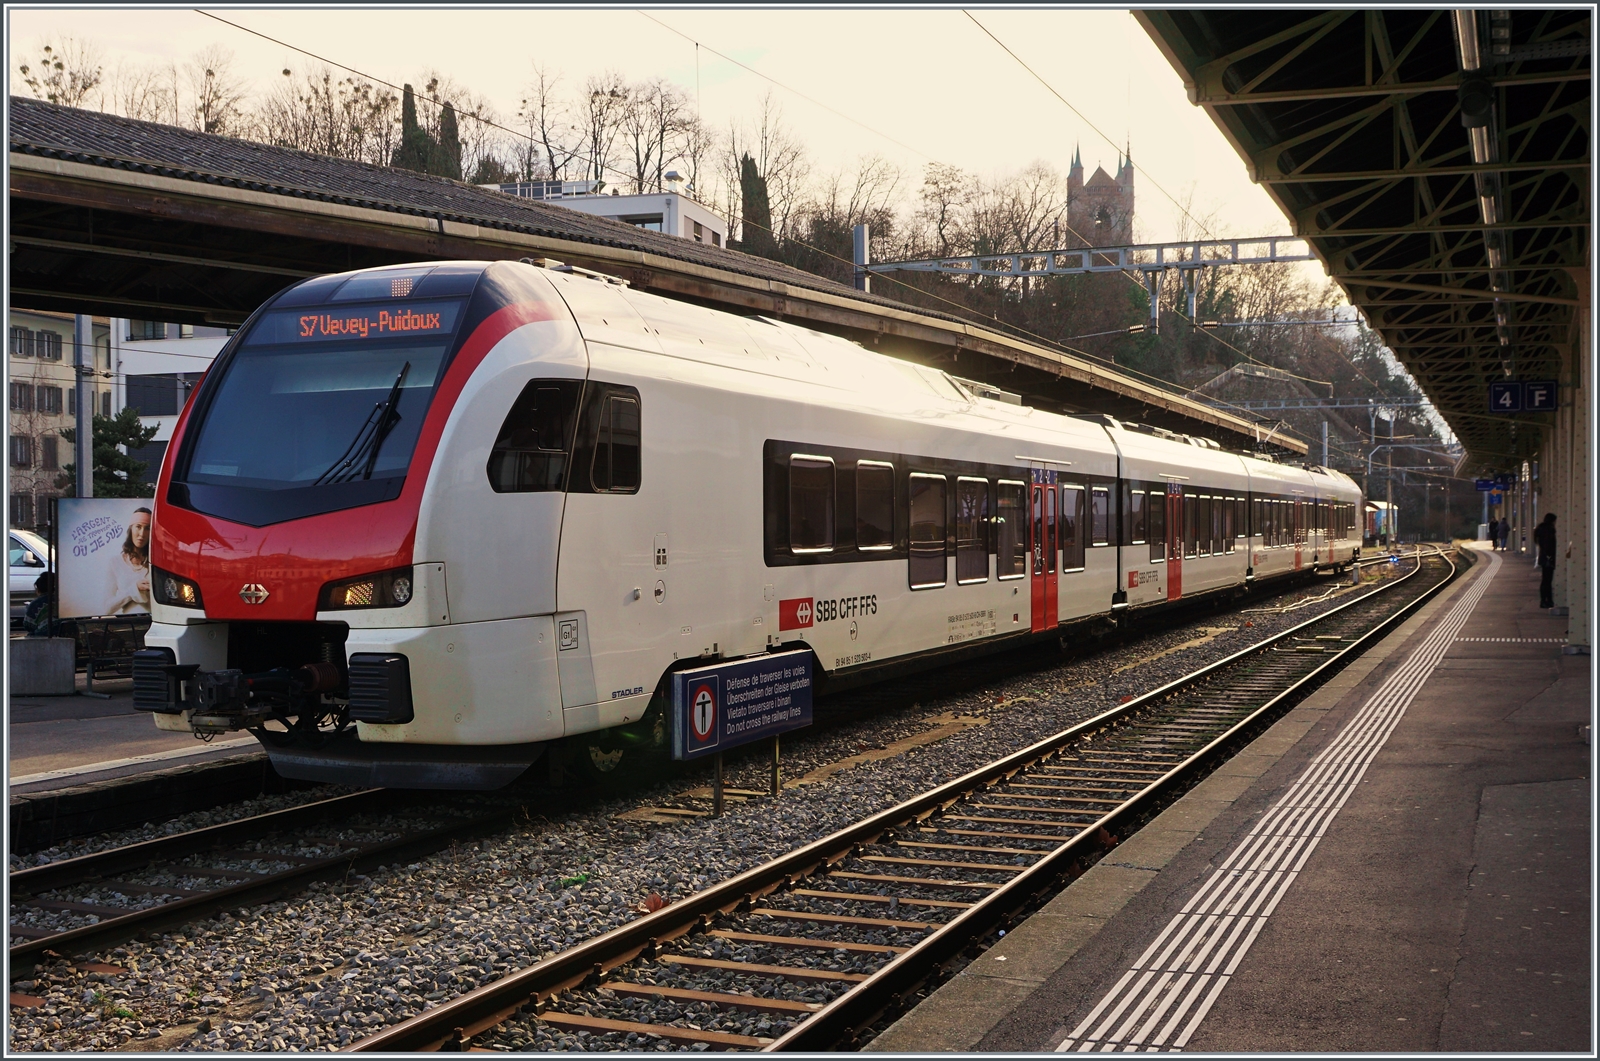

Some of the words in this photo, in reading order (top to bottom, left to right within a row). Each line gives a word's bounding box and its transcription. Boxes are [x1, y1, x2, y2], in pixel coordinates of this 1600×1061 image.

[300, 315, 318, 337] S7
[320, 309, 440, 338] Vevey-Puidoux
[1499, 391, 1512, 407] 4
[1534, 390, 1547, 407] F
[71, 516, 110, 541] L'ARGENT
[90, 536, 105, 553] JE
[106, 524, 123, 543] SUIS
[816, 599, 837, 623] SBB
[839, 596, 858, 619] CFF
[860, 594, 877, 616] FFS
[563, 631, 570, 640] G1
[726, 677, 751, 691] Défense
[751, 674, 759, 685] de
[760, 670, 783, 684] traverser
[792, 665, 805, 677] voies
[611, 687, 643, 699] STADLER
[727, 688, 764, 705] Überschreiten
[765, 685, 773, 697] der
[773, 682, 789, 694] Gleise
[790, 678, 810, 691] verboten
[727, 706, 747, 720] Vietato
[747, 699, 774, 715] traversare
[777, 694, 791, 707] binari
[726, 723, 735, 735] Do
[735, 719, 745, 731] not
[746, 716, 761, 730] cross
[762, 713, 771, 725] the
[771, 709, 789, 721] railway
[790, 706, 801, 718] lines
